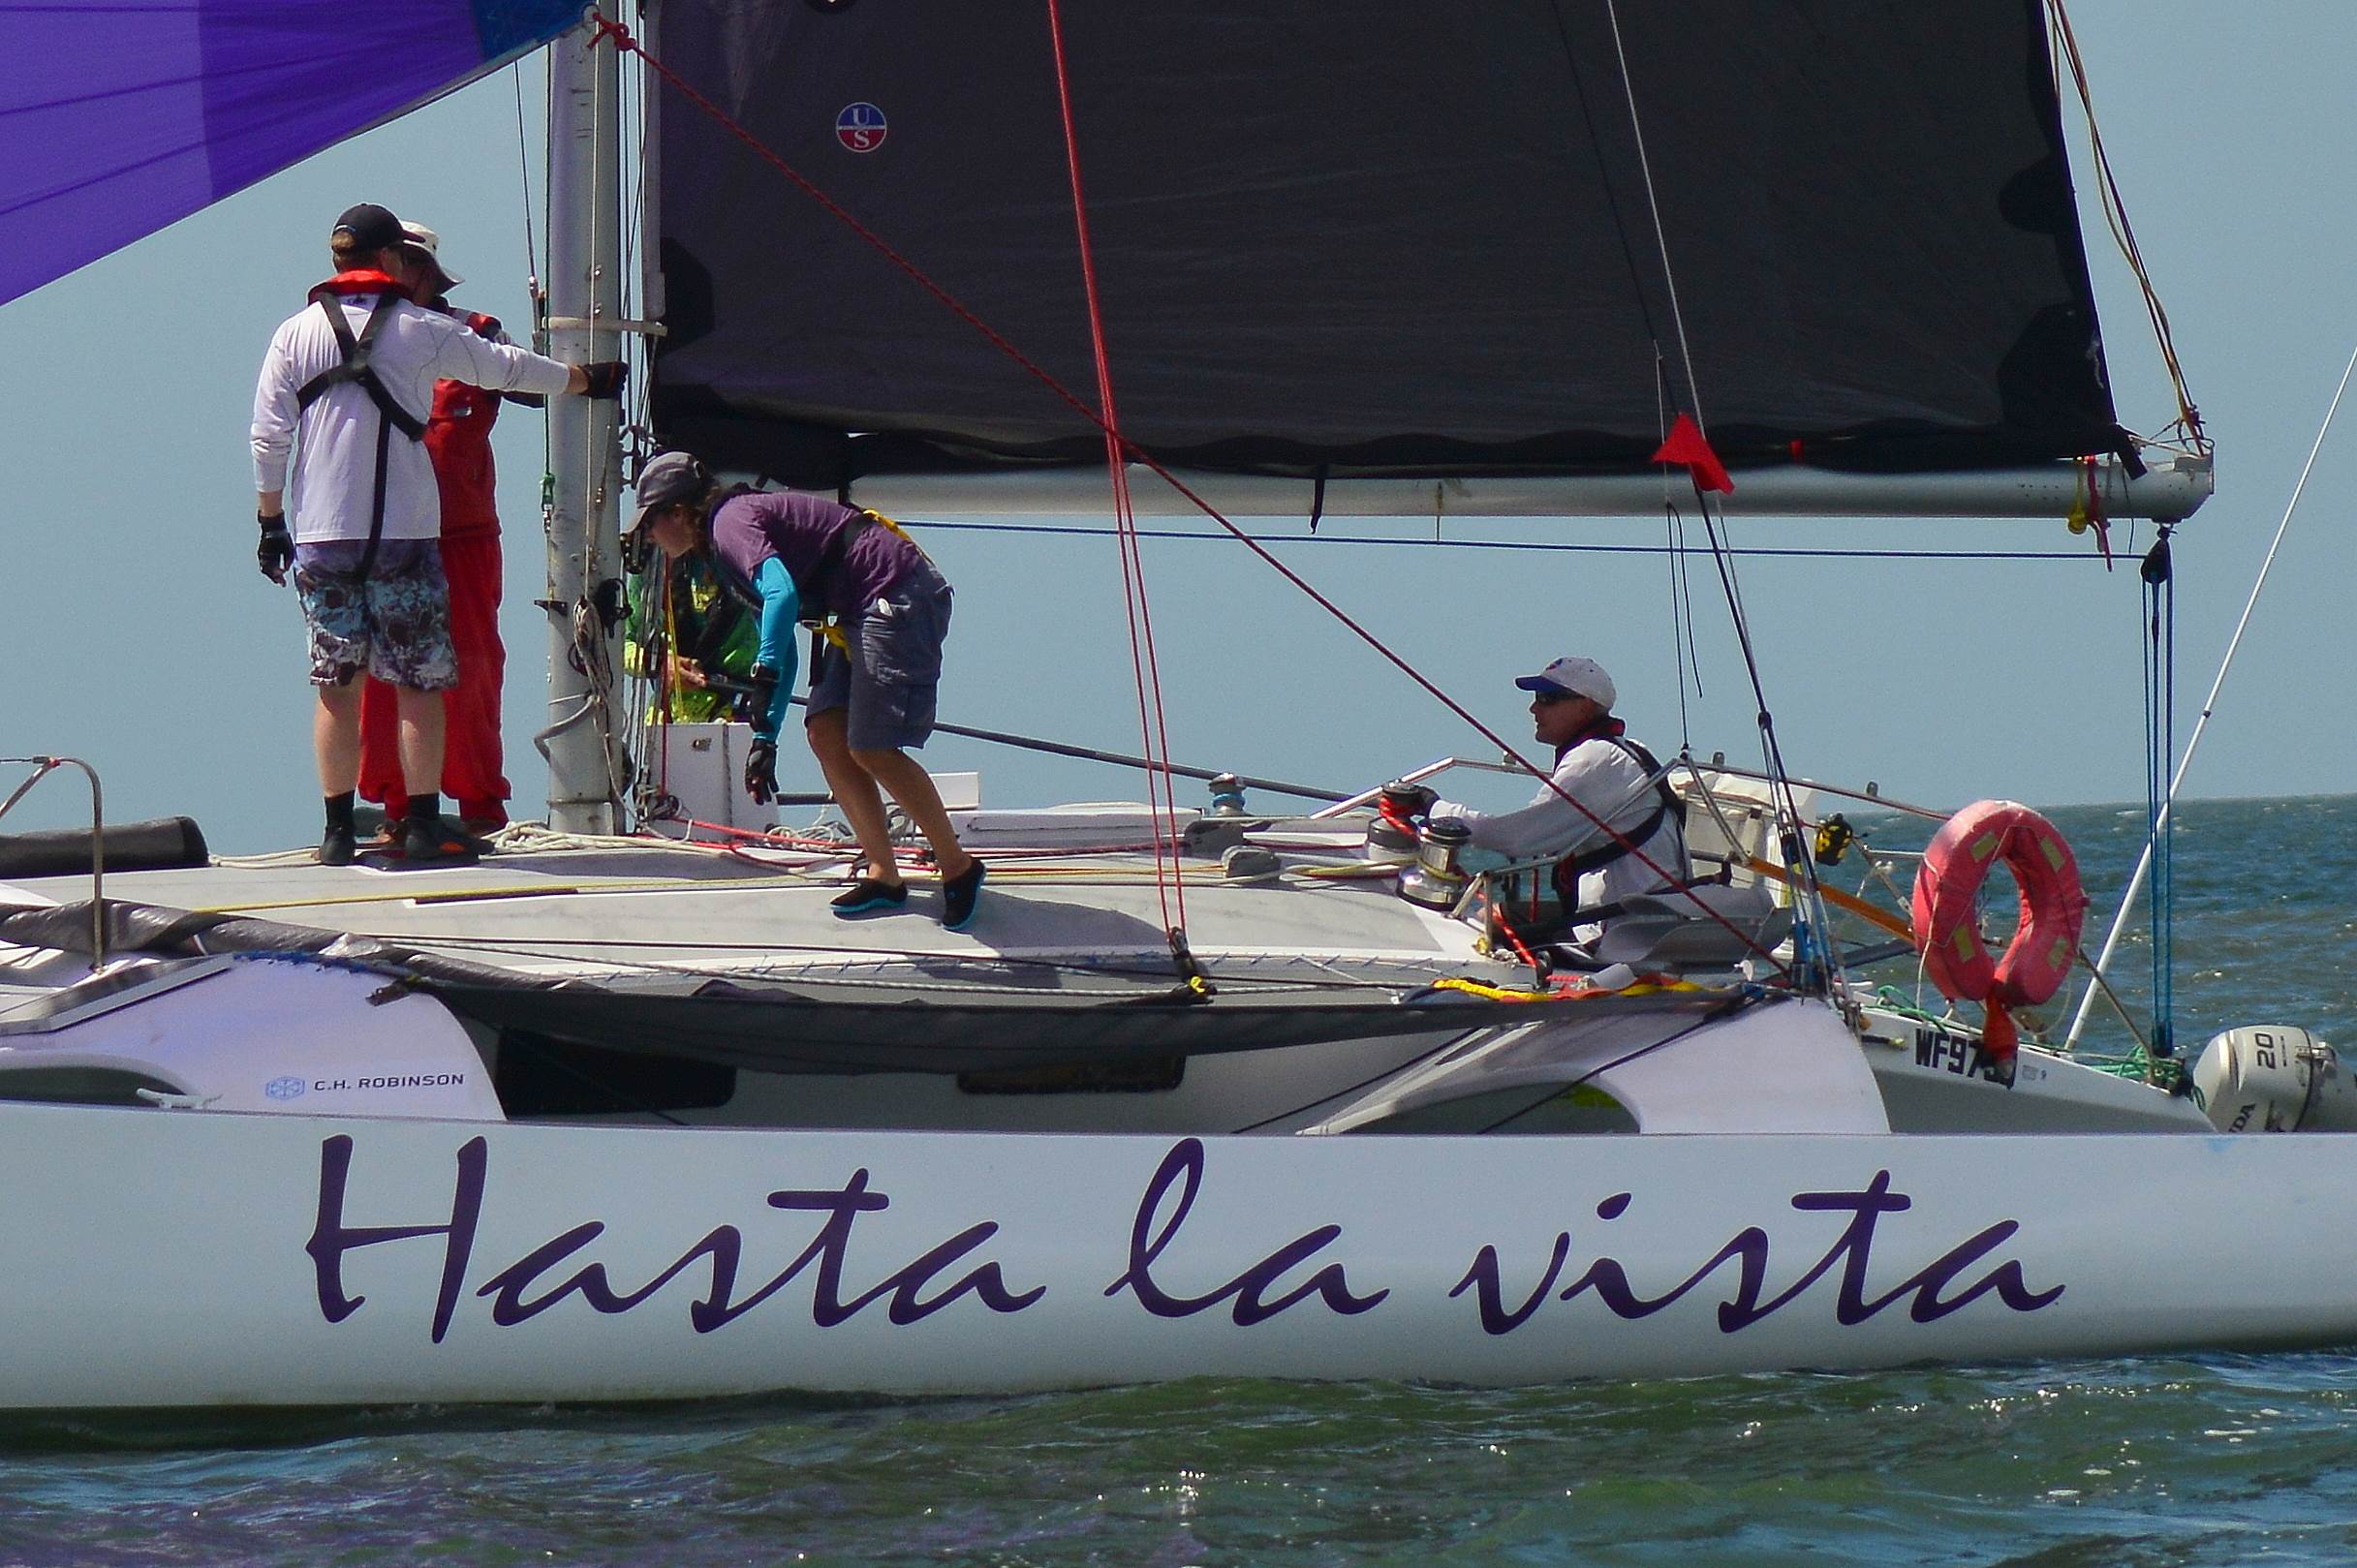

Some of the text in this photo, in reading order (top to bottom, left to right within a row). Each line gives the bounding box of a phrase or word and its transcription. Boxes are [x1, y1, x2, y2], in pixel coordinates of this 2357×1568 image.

[2254, 1032, 2277, 1069] 20
[314, 1073, 465, 1091] C.H. ROBINSON
[305, 1135, 2066, 1344] Hasta la vista
